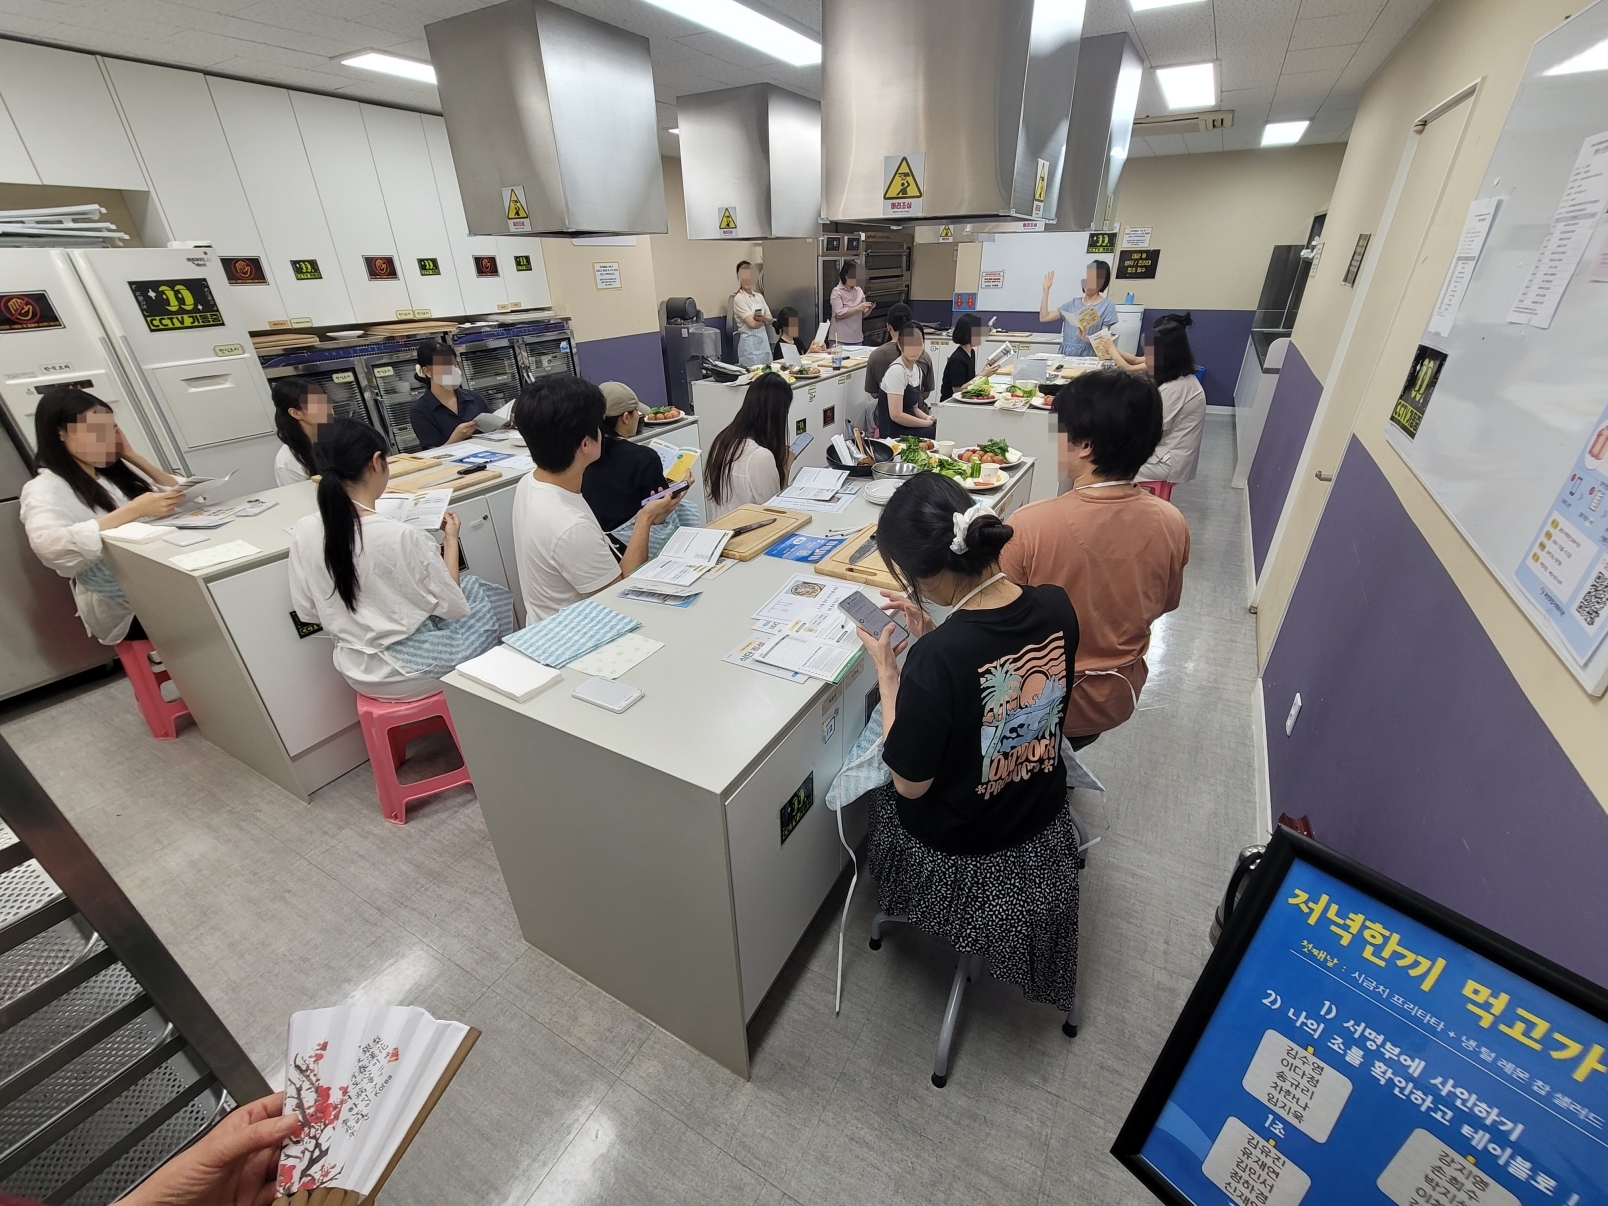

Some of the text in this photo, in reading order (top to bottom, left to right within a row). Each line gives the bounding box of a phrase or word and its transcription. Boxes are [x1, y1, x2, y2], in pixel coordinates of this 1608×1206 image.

[890, 201, 912, 210] 머리조심
[149, 316, 185, 328] CCTV
[1287, 888, 1447, 992] 저녁한끼
[1300, 939, 1339, 968] 첫째날
[1351, 970, 1390, 999] 시금치
[1390, 993, 1446, 1033] 프리타타
[1552, 1091, 1606, 1131] 샐러드
[1280, 1058, 1320, 1088] 이다정
[1285, 1045, 1325, 1076] 김수영
[1319, 1000, 1526, 1143] 1) 서명부에 사인하기
[374, 1074, 393, 1097] Korea
[1261, 989, 1282, 1010] 2)
[1287, 1007, 1325, 1040] 나의
[1326, 1034, 1365, 1068] 조를
[1370, 1059, 1454, 1127] 확인하고
[1460, 1123, 1560, 1197] 테이블로
[1270, 1081, 1310, 1112] 차한나
[1275, 1070, 1315, 1101] 송규리
[1264, 1113, 1285, 1138] 1조
[1240, 1146, 1280, 1182] 유재연
[1246, 1133, 1286, 1170] 김유진
[1230, 1168, 1269, 1205] 정하경
[1235, 1157, 1275, 1194] 김민서
[1437, 1149, 1490, 1194] 강지영
